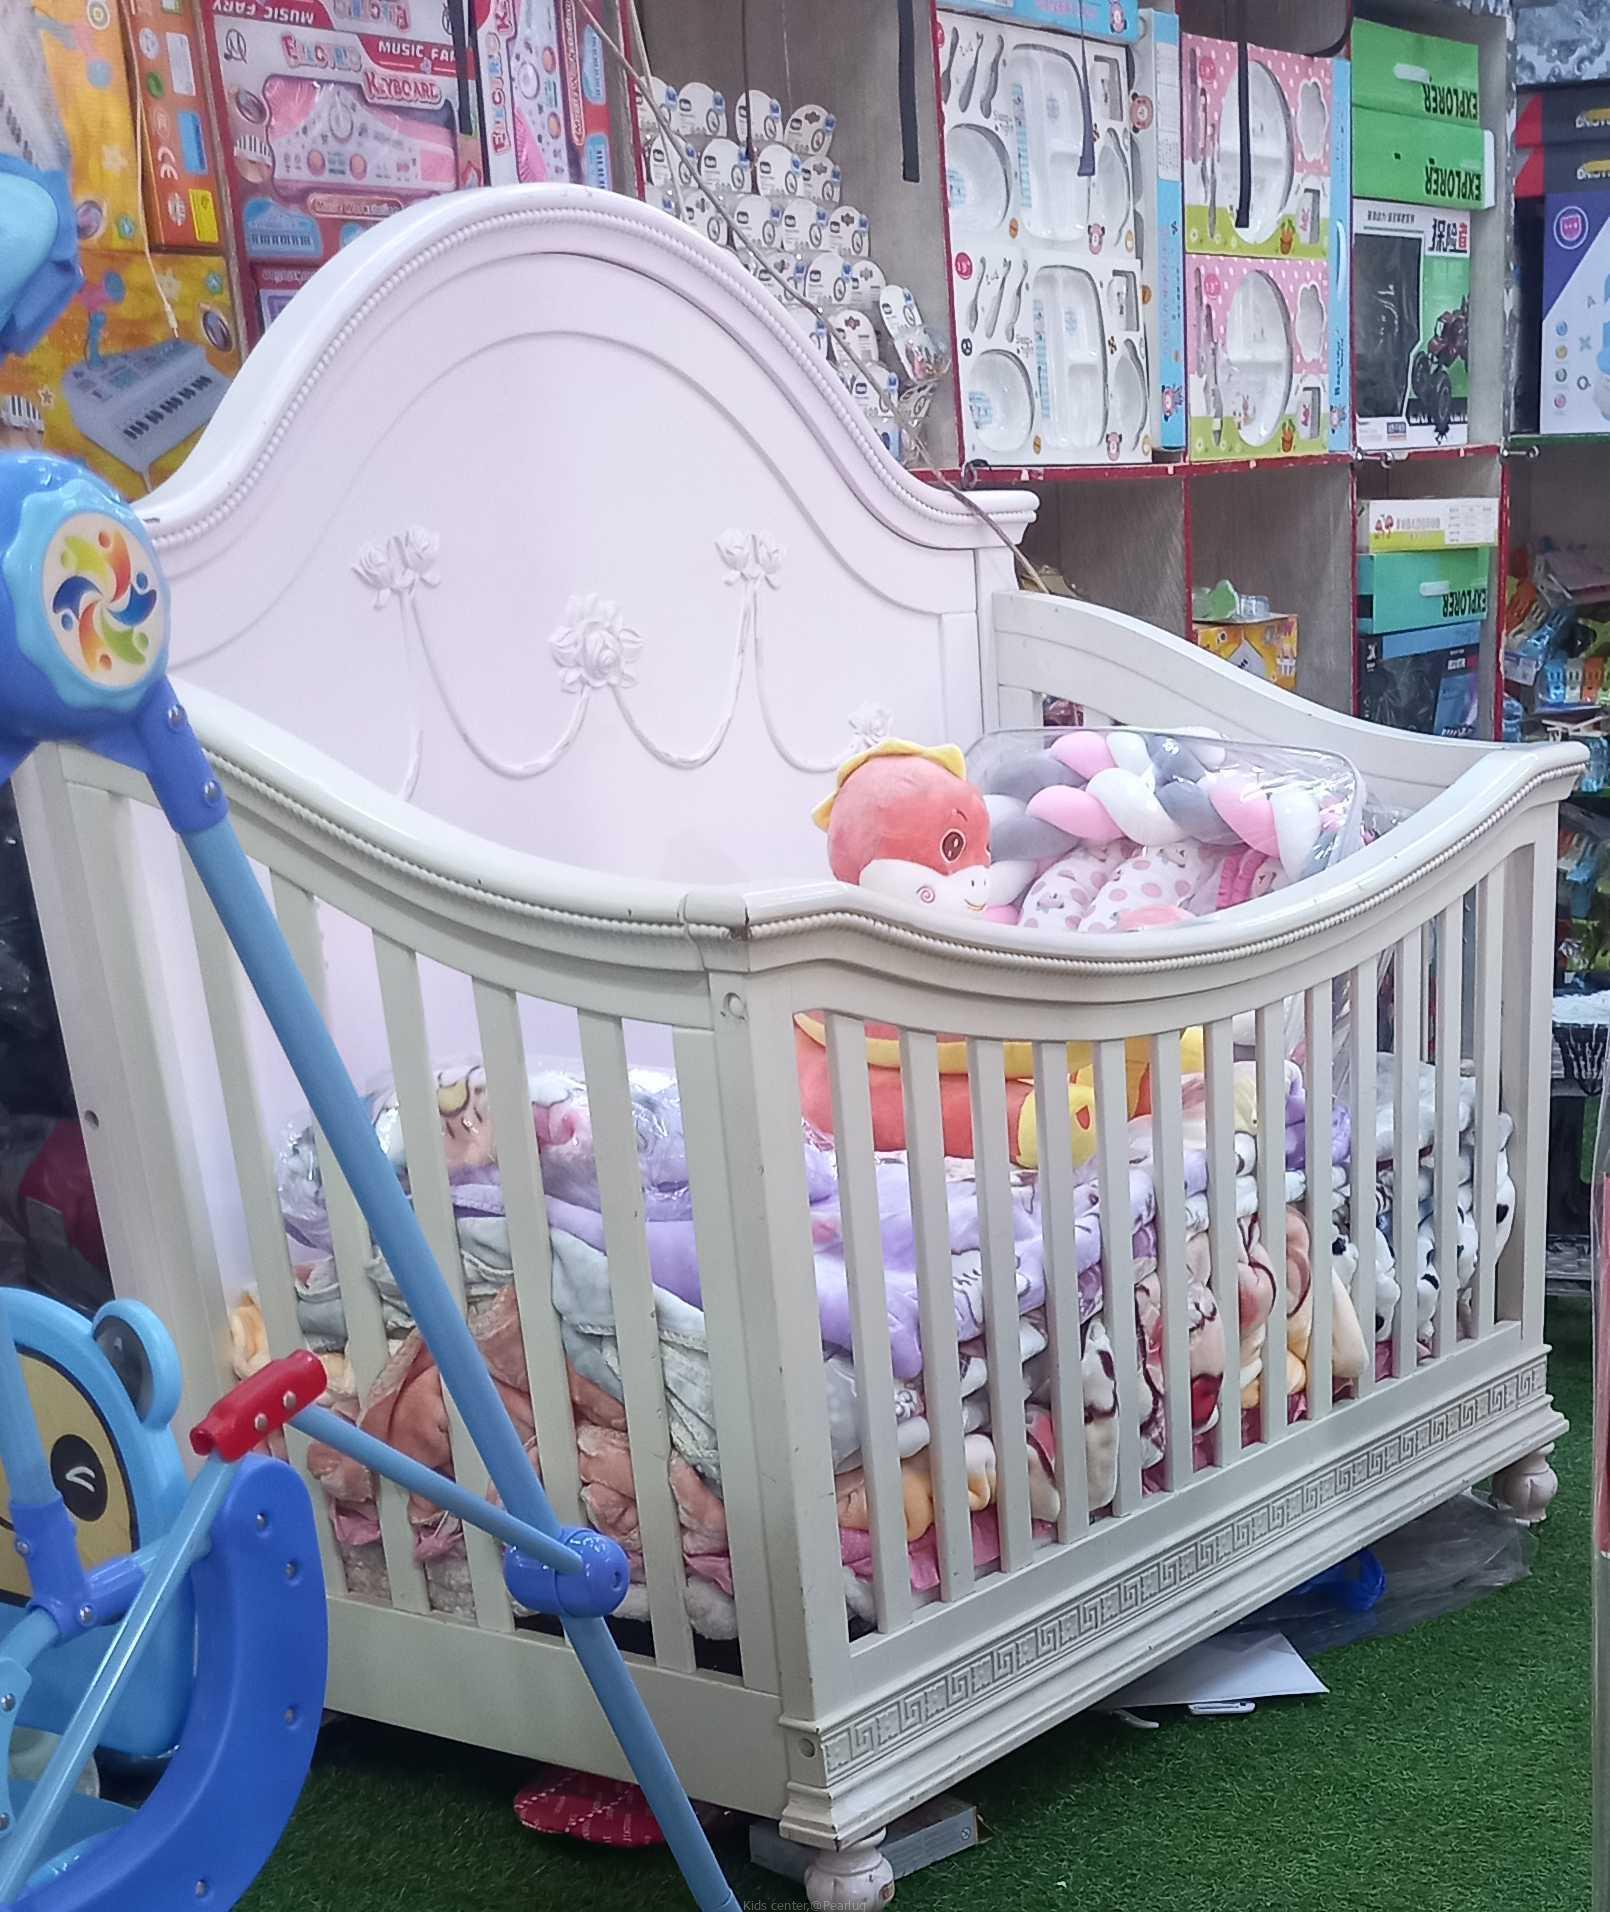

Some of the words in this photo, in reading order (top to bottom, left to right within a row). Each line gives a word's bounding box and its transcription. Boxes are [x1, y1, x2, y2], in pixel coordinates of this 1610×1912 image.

[262, 6, 315, 25] MUSIC
[378, 40, 424, 58] MUSIC
[1422, 83, 1478, 120] EXPLORER
[1425, 166, 1482, 201] EXPLORER
[1441, 588, 1487, 618] EXPLORER
